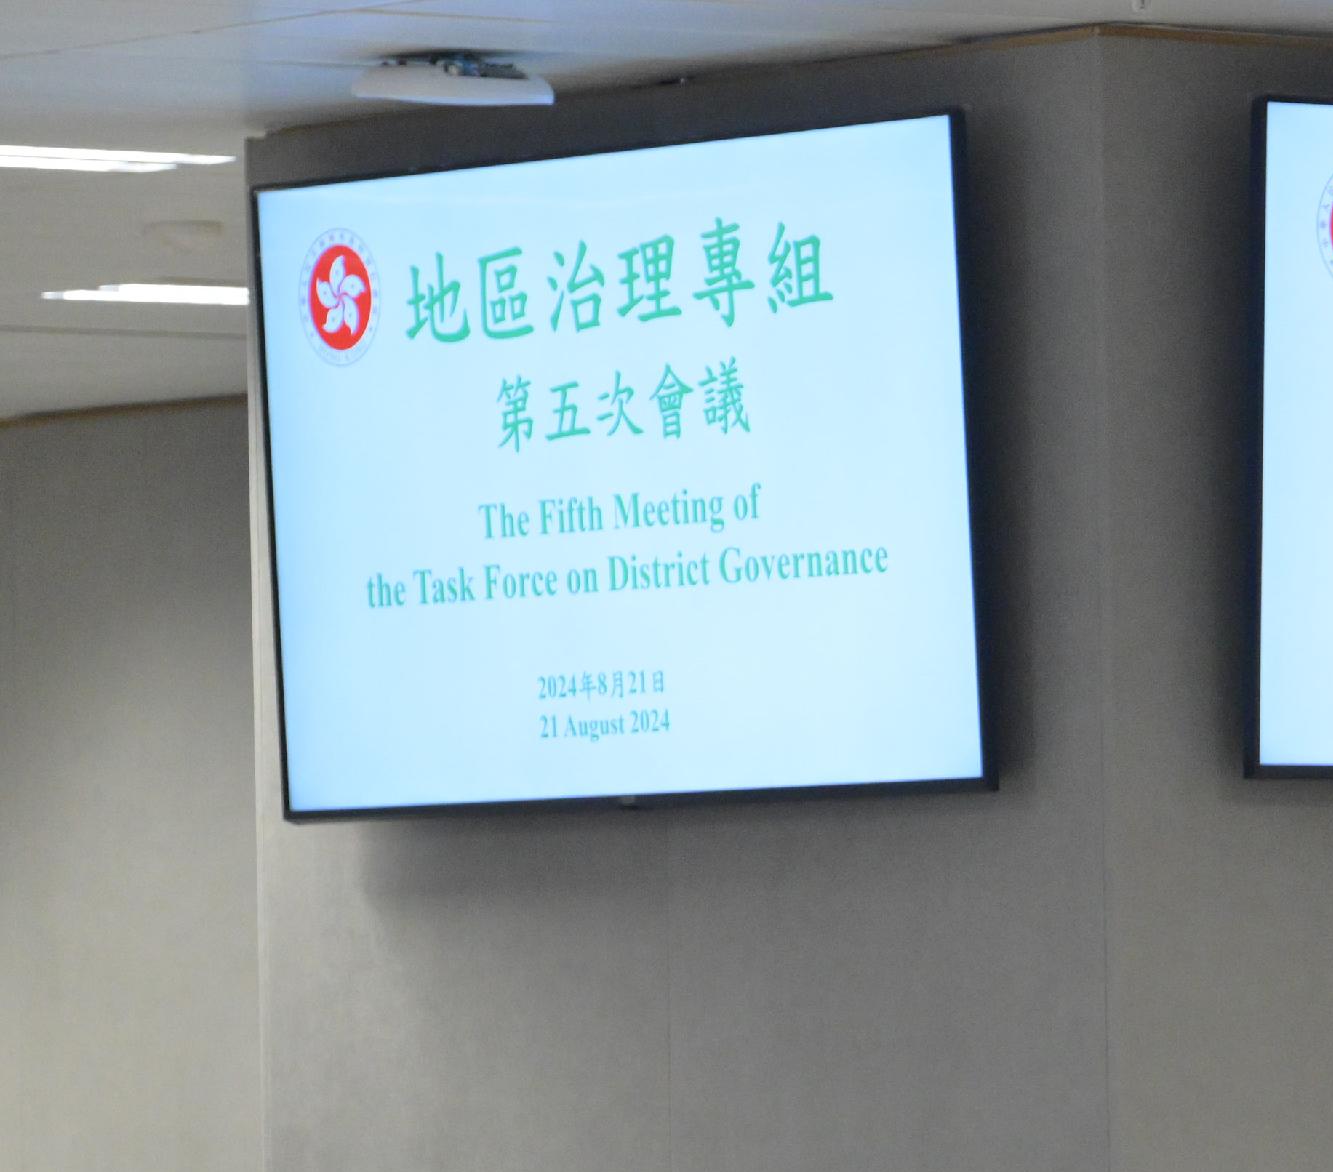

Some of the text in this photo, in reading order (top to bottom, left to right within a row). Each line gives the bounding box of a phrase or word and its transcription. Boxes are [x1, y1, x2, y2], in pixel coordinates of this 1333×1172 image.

[403, 214, 835, 346] 地區治理專組
[493, 353, 753, 455] 第五次會議
[475, 480, 763, 541] The Fifth Meeting of
[364, 545, 890, 610] the Task Force on District Governance
[535, 668, 666, 701] 2024年8月21日
[537, 707, 672, 743] 21 August 2024
